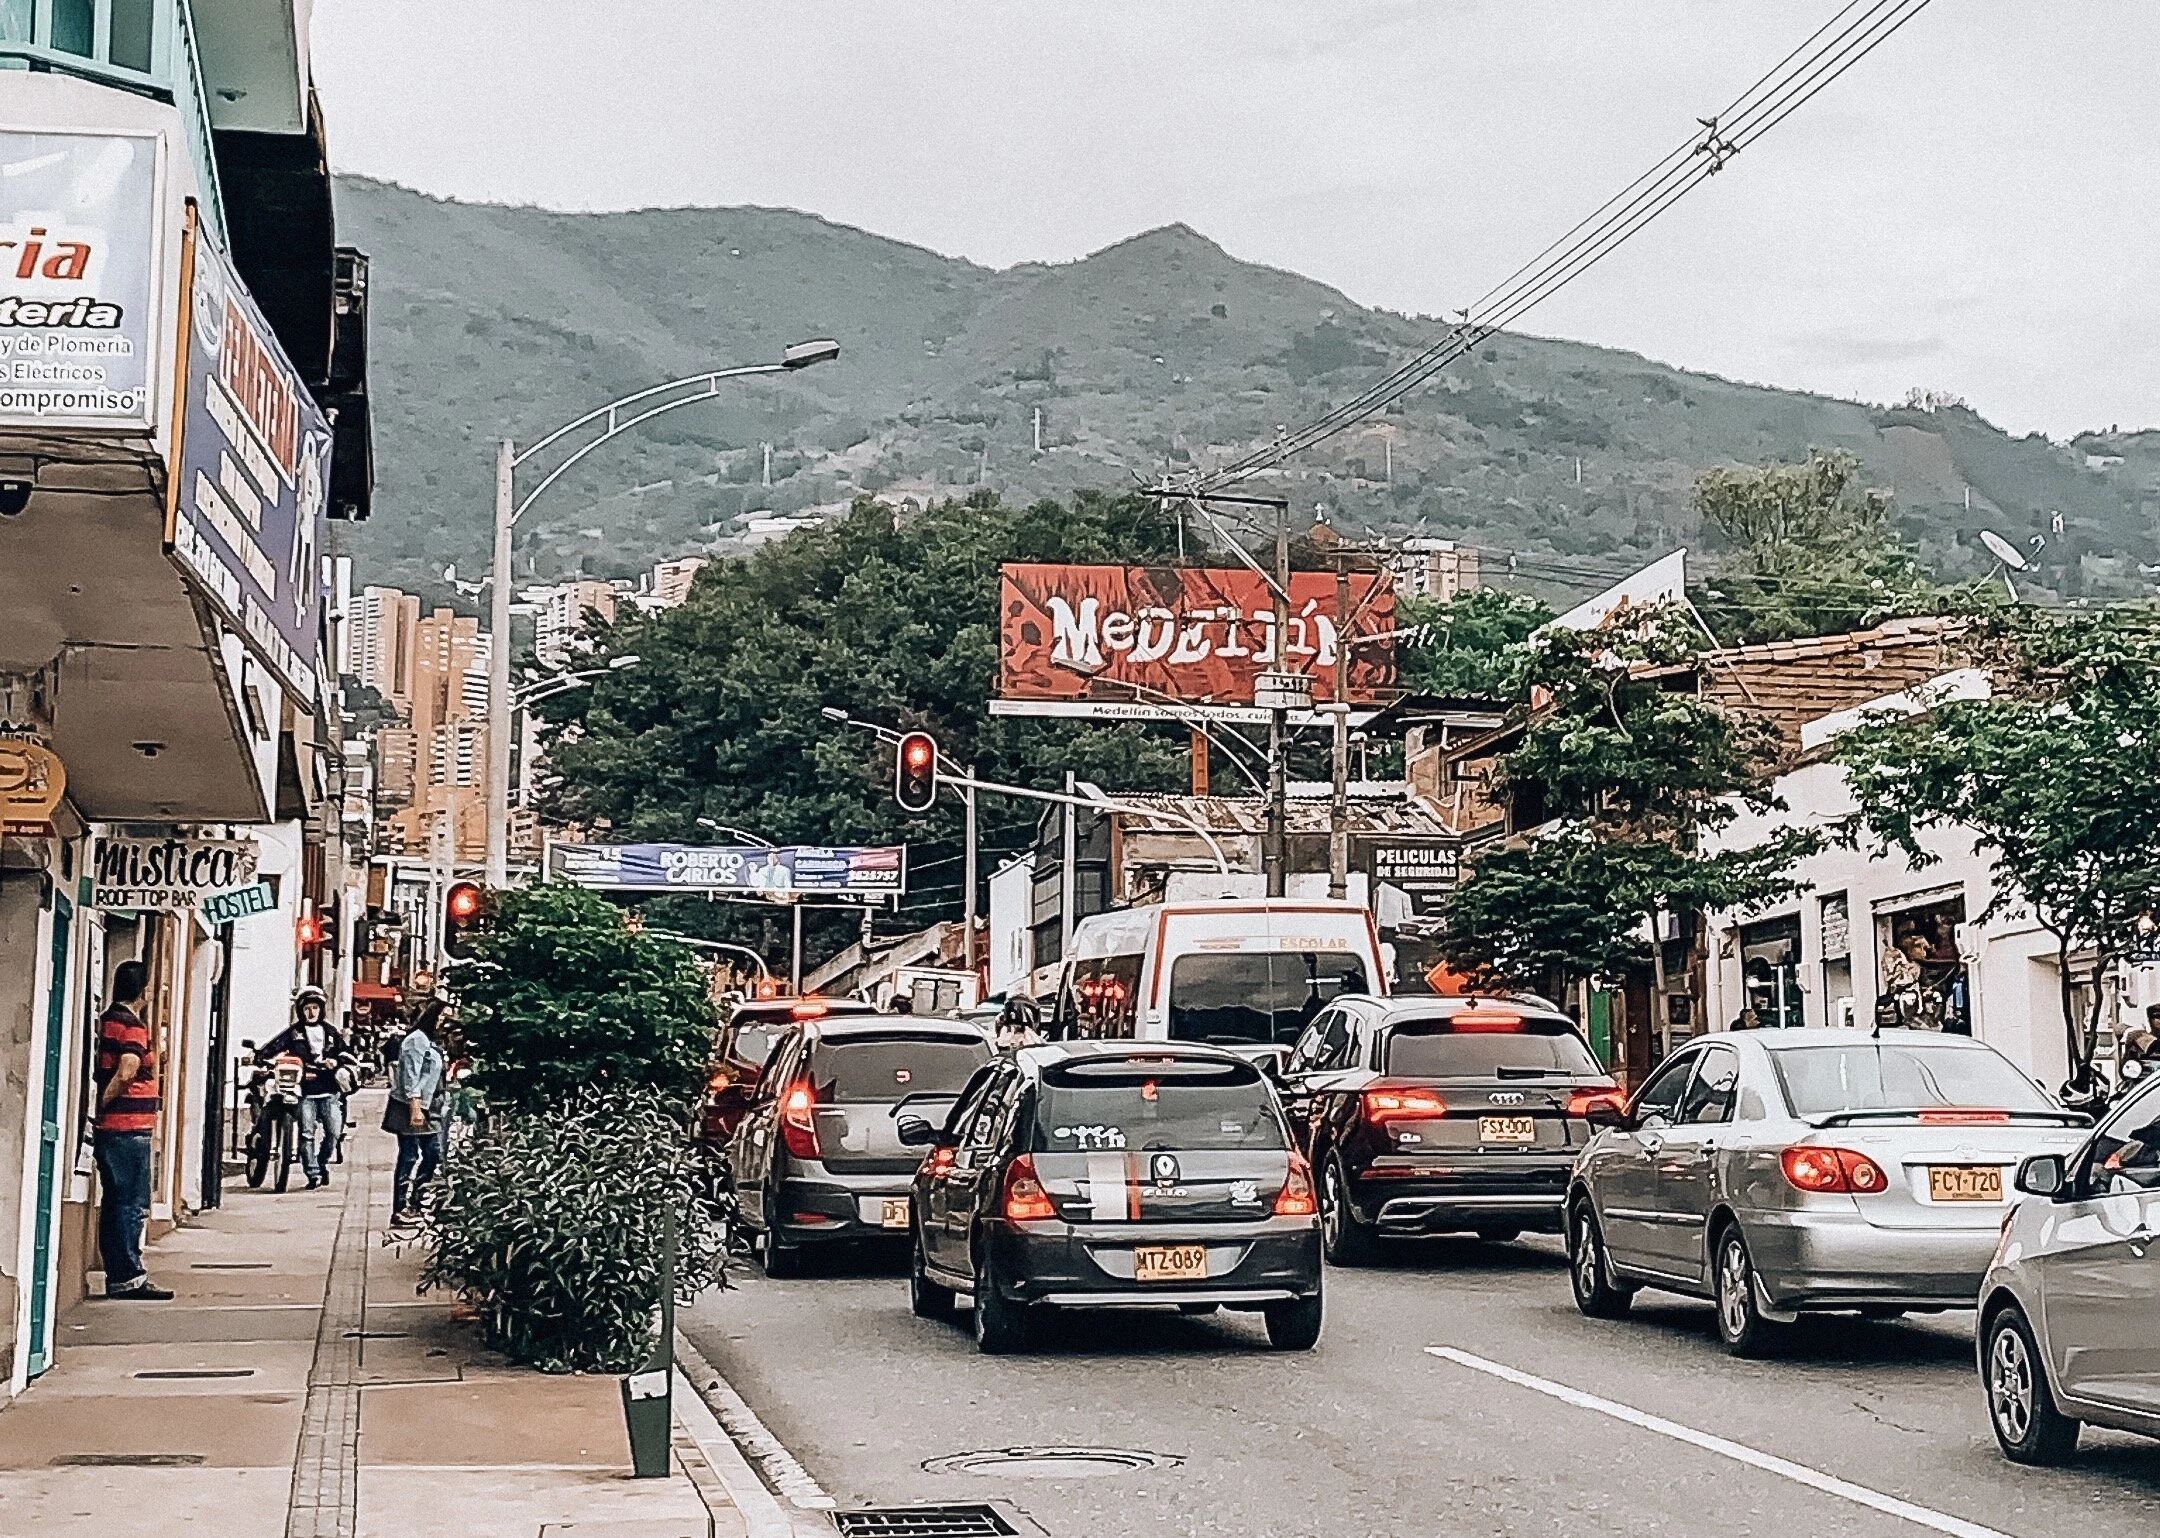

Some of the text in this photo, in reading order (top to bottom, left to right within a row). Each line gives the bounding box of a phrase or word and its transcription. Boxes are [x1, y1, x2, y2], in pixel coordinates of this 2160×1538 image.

[1, 339, 11, 355] y
[18, 336, 40, 351] de
[660, 851, 744, 869] ROBERTO
[1376, 849, 1456, 865] PELICULAS
[665, 867, 737, 884] CARLOS
[171, 889, 197, 906] BAR
[204, 884, 274, 924] HOSTEL
[1279, 937, 1348, 949] ESCOLAR
